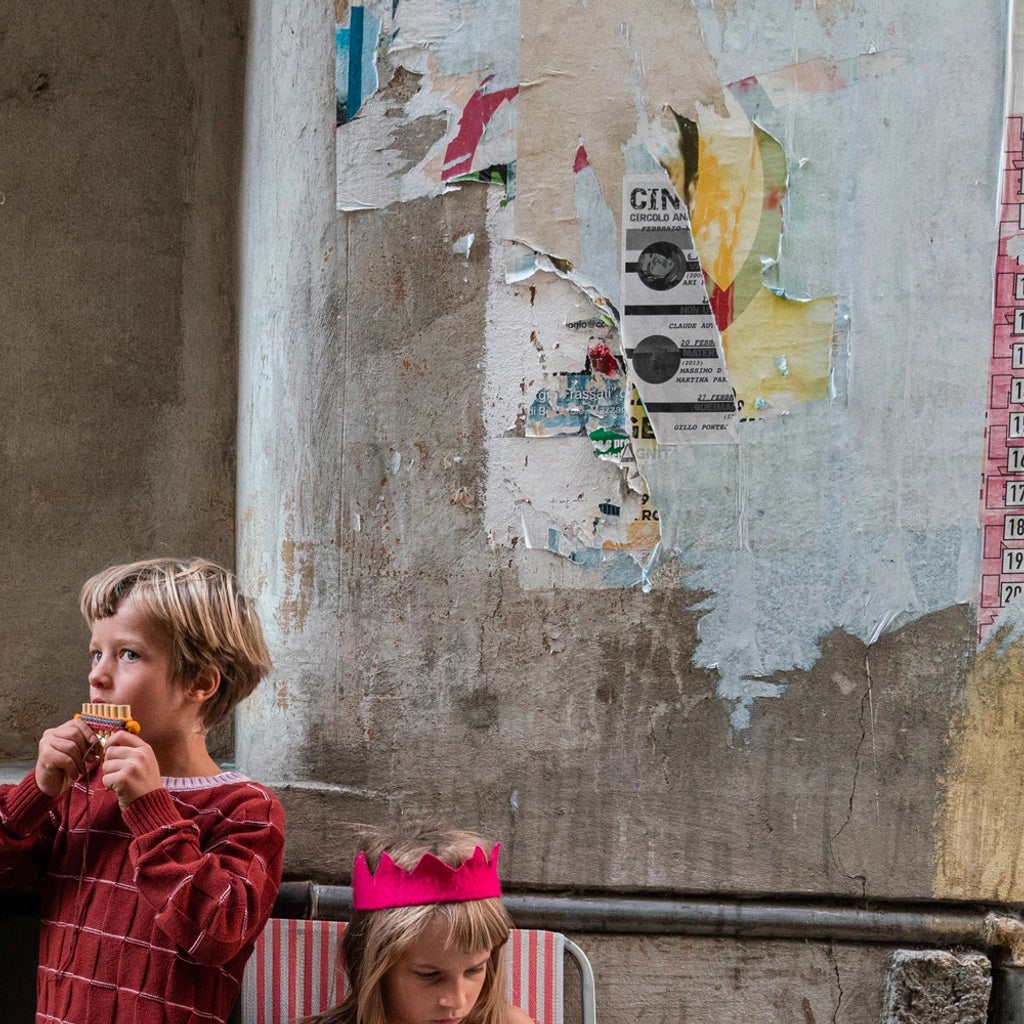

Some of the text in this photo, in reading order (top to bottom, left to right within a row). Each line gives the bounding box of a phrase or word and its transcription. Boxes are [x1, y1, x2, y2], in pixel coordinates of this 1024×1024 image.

[630, 213, 669, 222] CIRCOLO
[1009, 518, 1024, 536] 18
[1007, 552, 1023, 569] 19
